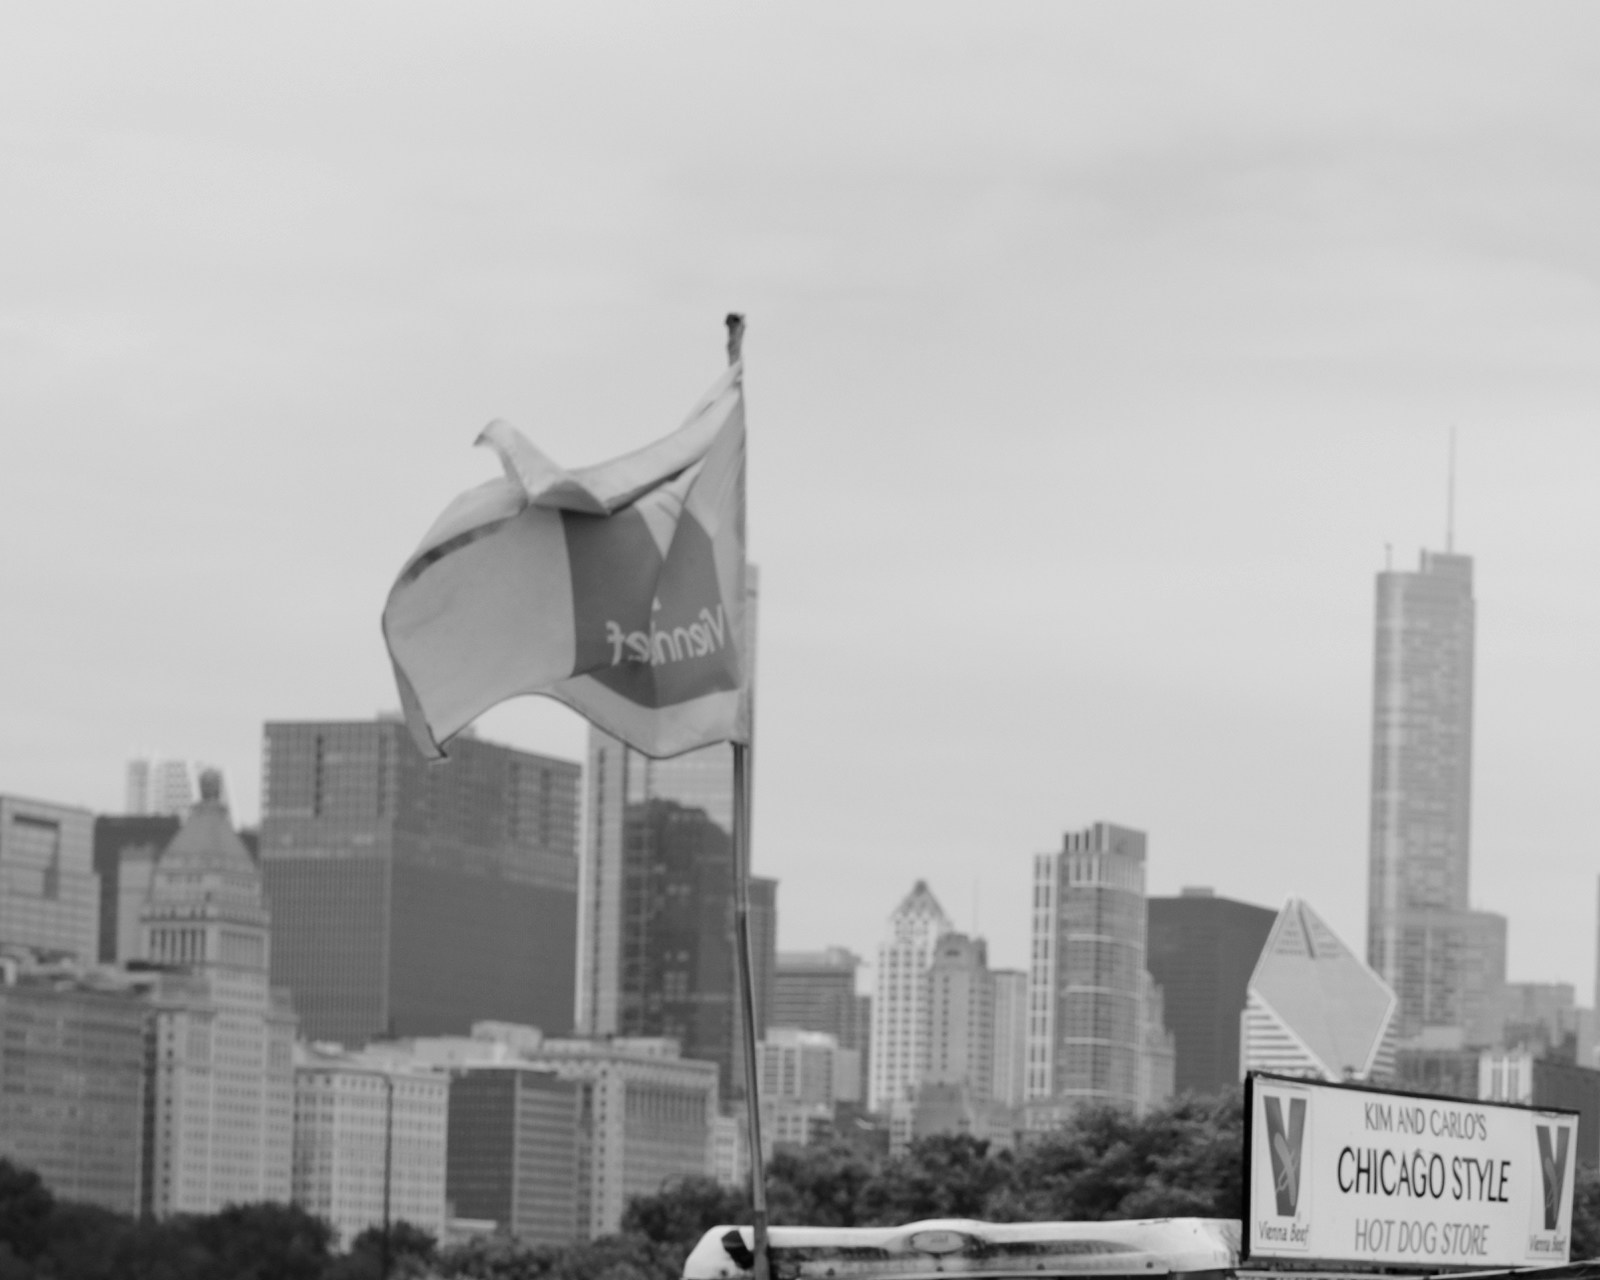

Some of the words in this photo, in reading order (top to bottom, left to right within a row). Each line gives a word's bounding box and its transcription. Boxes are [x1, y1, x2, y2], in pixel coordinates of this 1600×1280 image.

[1365, 1102, 1392, 1132] KIM
[1397, 1105, 1424, 1136] AND
[1430, 1111, 1487, 1141] CARLO'S
[1337, 1146, 1445, 1198] CHICAGO
[1452, 1157, 1511, 1203] STYLE
[1258, 1221, 1288, 1242] Vienna
[1290, 1223, 1309, 1245] Beef
[1355, 1218, 1394, 1252] HOT
[1399, 1220, 1437, 1255] DOG
[1441, 1222, 1490, 1257] STORE
